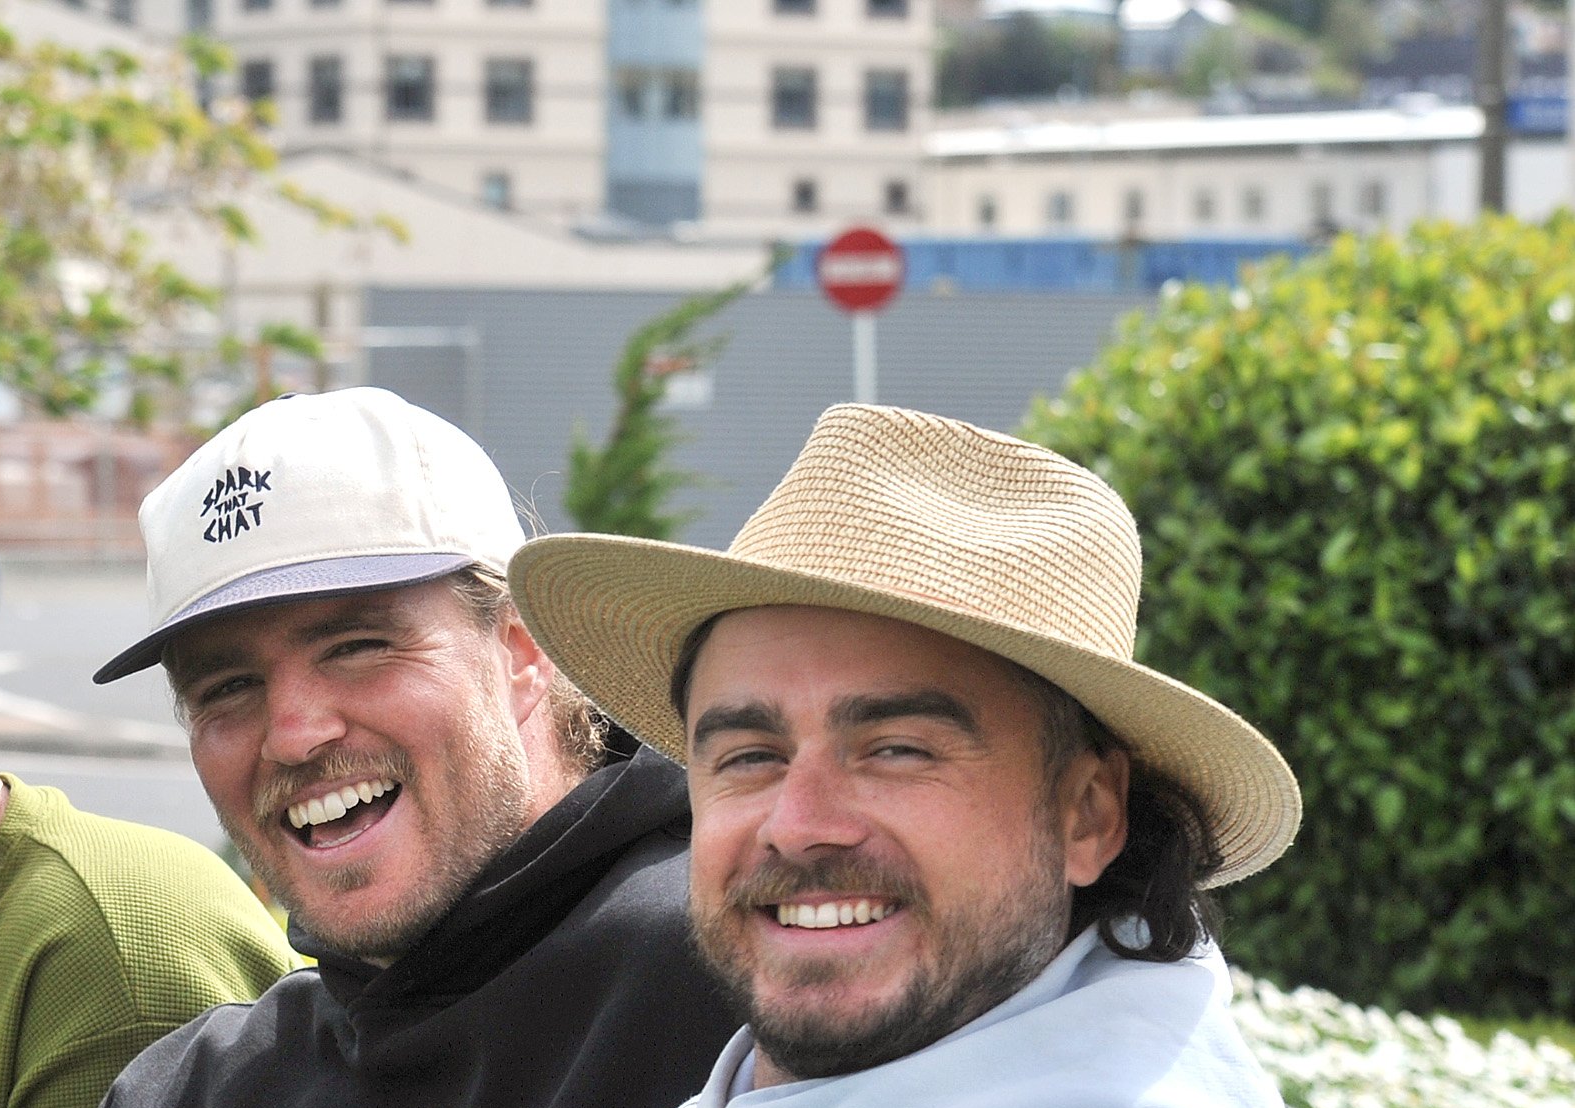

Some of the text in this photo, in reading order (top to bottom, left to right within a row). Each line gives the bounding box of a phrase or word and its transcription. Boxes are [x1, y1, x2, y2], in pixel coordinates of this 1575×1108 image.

[200, 466, 272, 517] SPARK
[215, 492, 248, 516] THAT
[203, 501, 264, 543] CHAT
